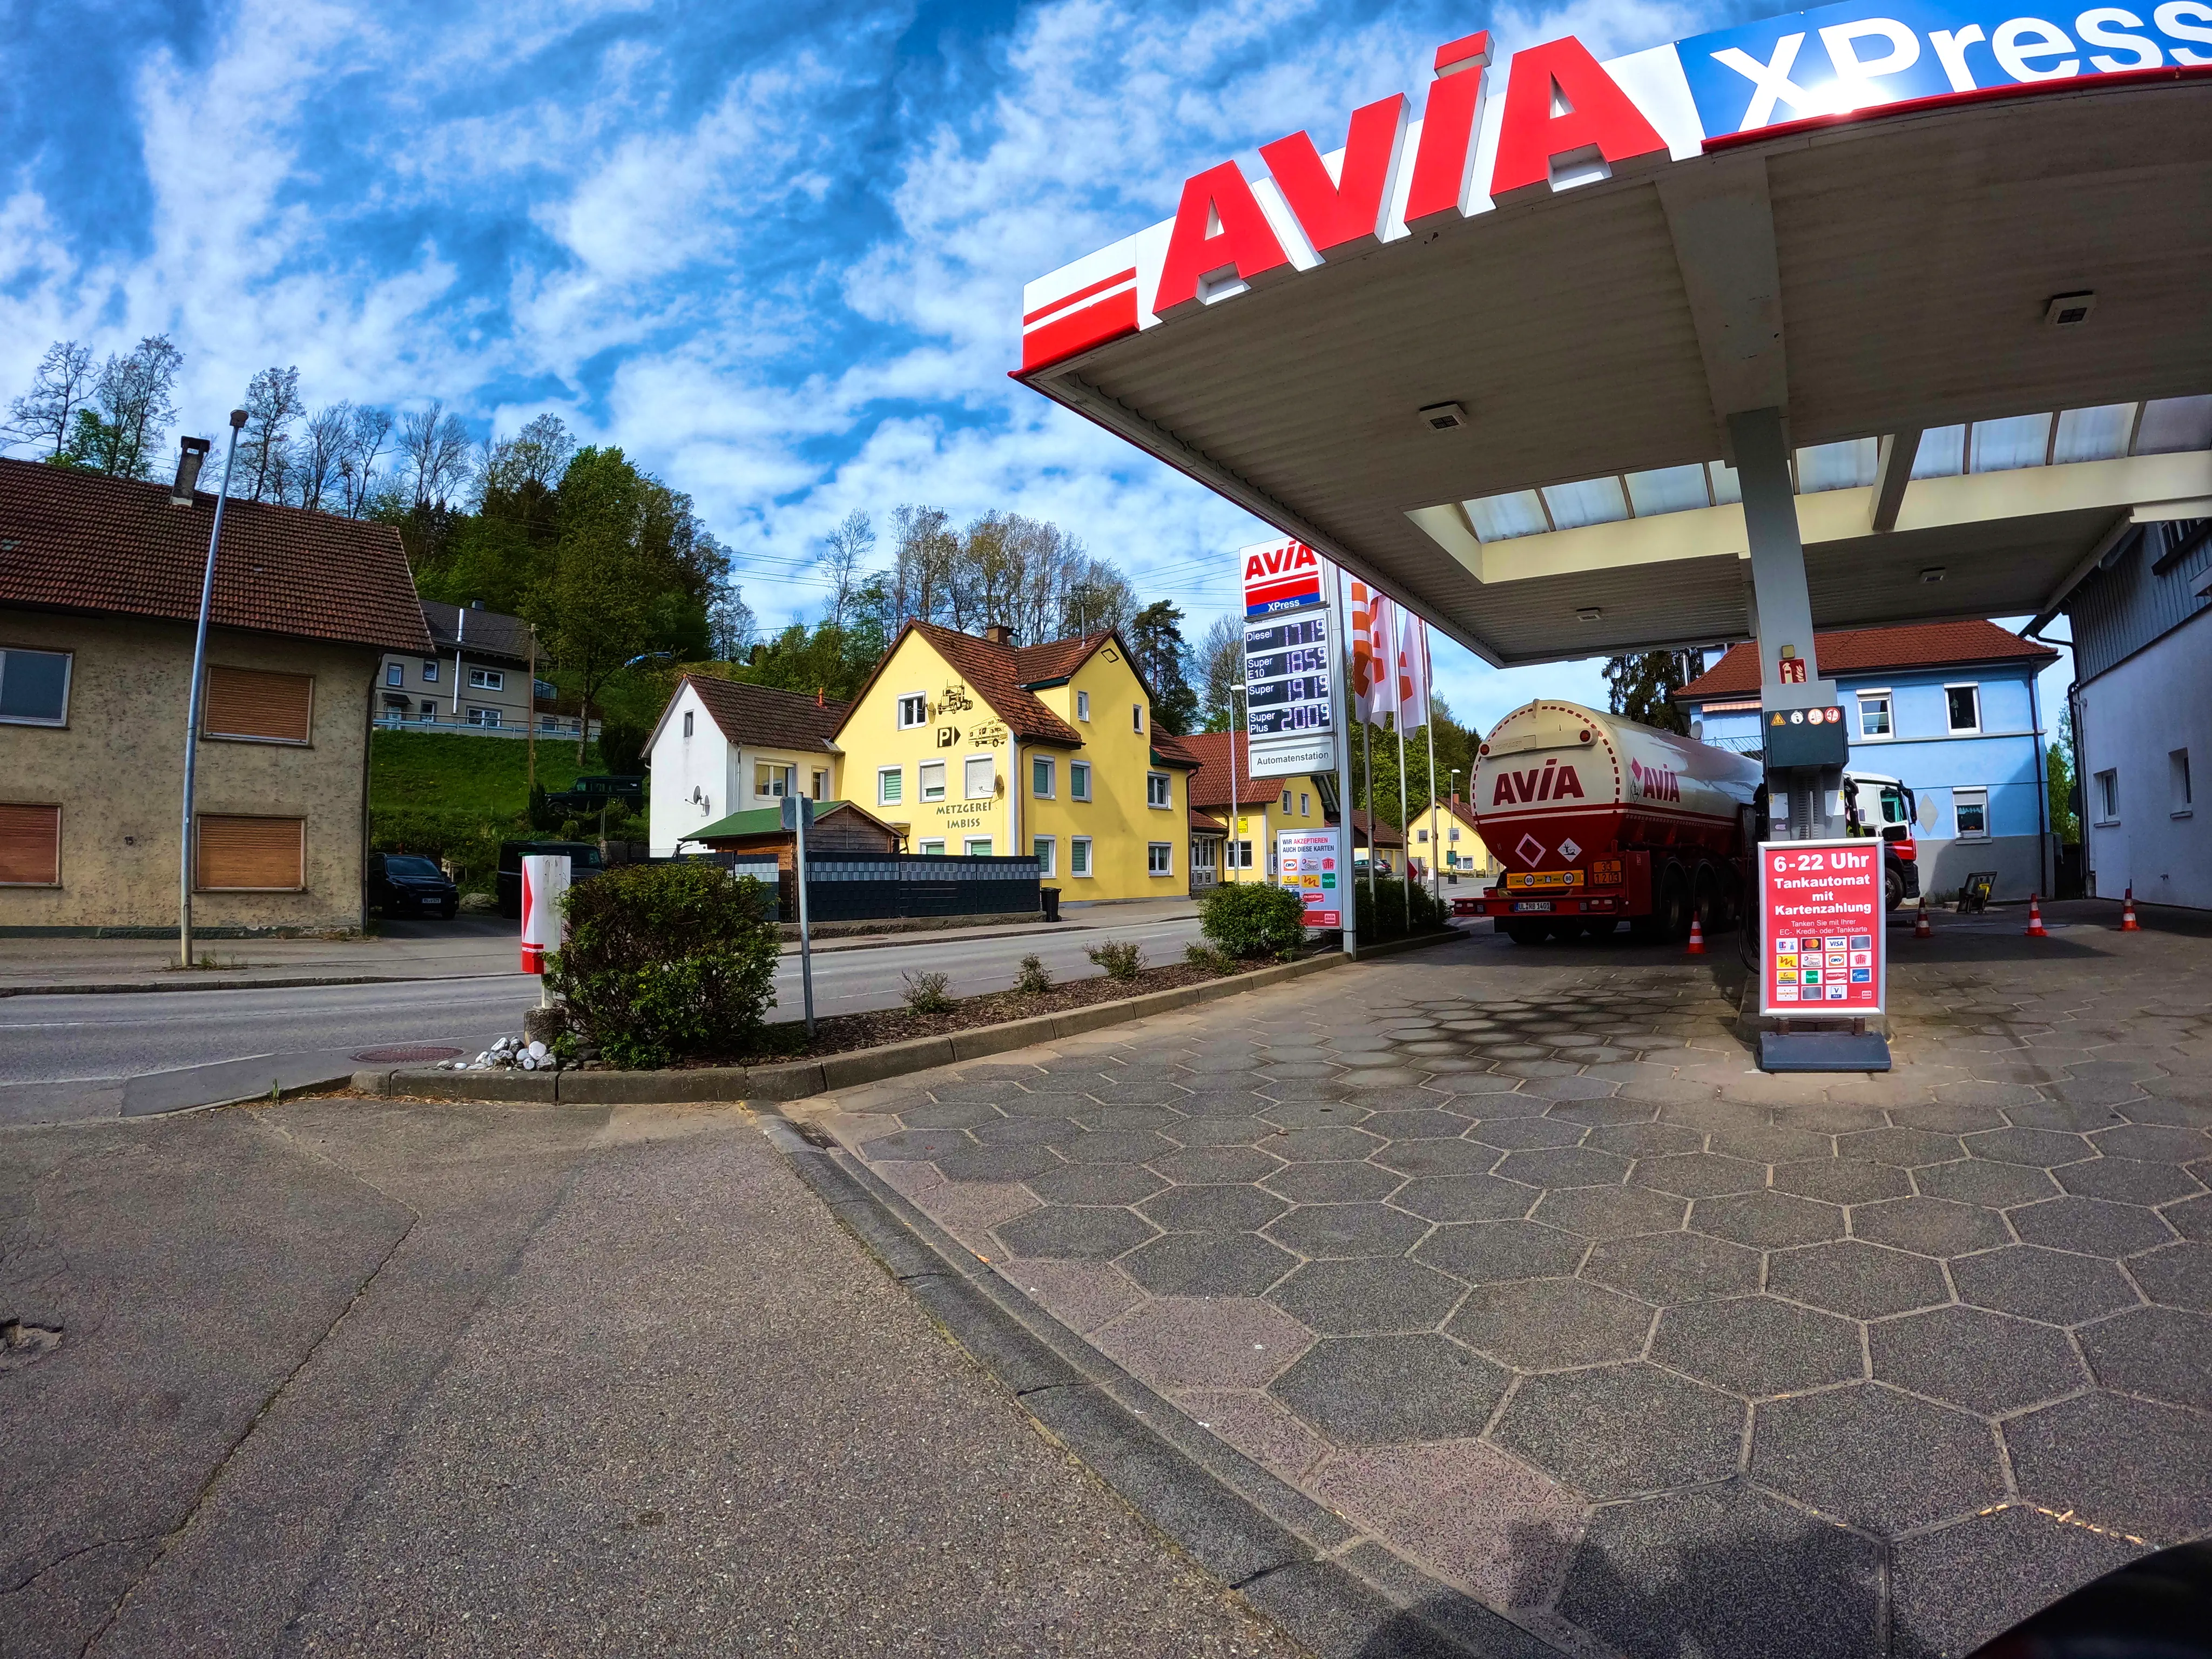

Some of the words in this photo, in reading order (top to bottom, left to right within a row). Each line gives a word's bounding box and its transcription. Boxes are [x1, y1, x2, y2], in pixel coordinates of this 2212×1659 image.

[1153, 30, 1670, 314] AVIA
[1244, 541, 1317, 581] AVIA
[1267, 599, 1300, 612] XPress
[1246, 630, 1272, 641] Diesel
[1248, 657, 1273, 669] Super
[1248, 669, 1265, 679] E10
[1249, 684, 1274, 696] Super
[1250, 712, 1276, 724] Super
[1250, 721, 1269, 733] Plus
[940, 729, 950, 746] P
[1257, 751, 1329, 766] Automatenstation
[1493, 758, 1584, 806] AVIA
[1643, 763, 1681, 803] AVIA
[936, 802, 992, 815] METZGEREI
[947, 818, 980, 829] IMBISS
[1324, 859, 1334, 869] UTA
[1601, 861, 1612, 871] 33
[1831, 852, 1870, 869] Uhr
[1595, 873, 1620, 883] 1203
[1774, 874, 1870, 889] Tankautomat
[1812, 891, 1834, 901] mit
[1775, 903, 1871, 915] Kartenzahlung
[1856, 955, 1865, 963] UTA
